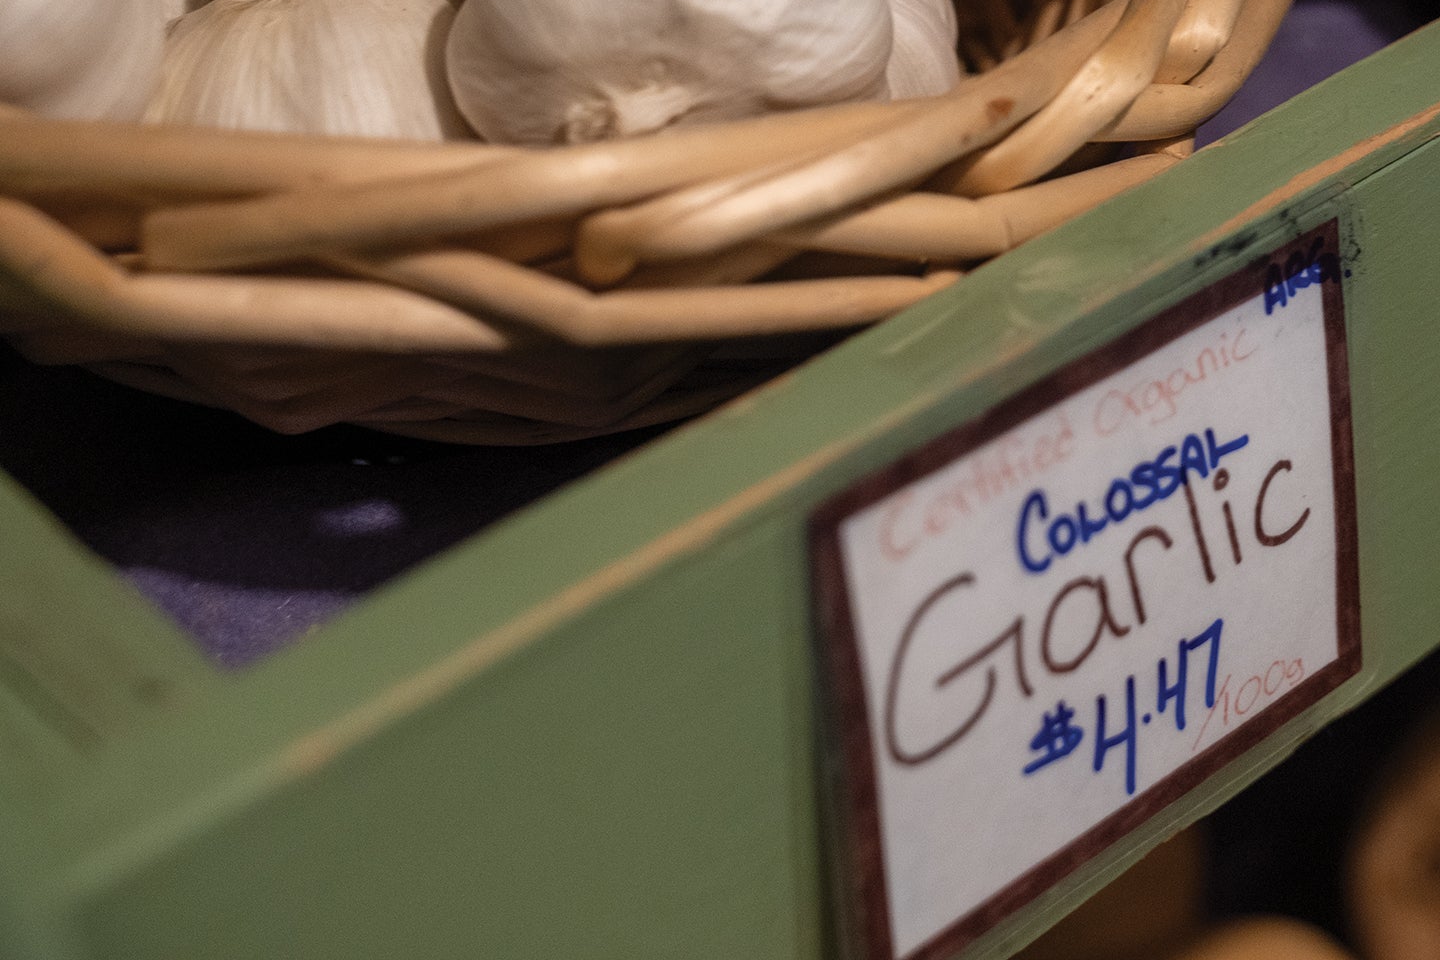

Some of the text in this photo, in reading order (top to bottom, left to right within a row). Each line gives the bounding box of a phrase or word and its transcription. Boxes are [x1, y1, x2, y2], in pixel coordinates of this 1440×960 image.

[877, 328, 1259, 561] Certified Organic
[1016, 428, 1250, 573] COLOSSAL
[886, 459, 1312, 767] Garlic
